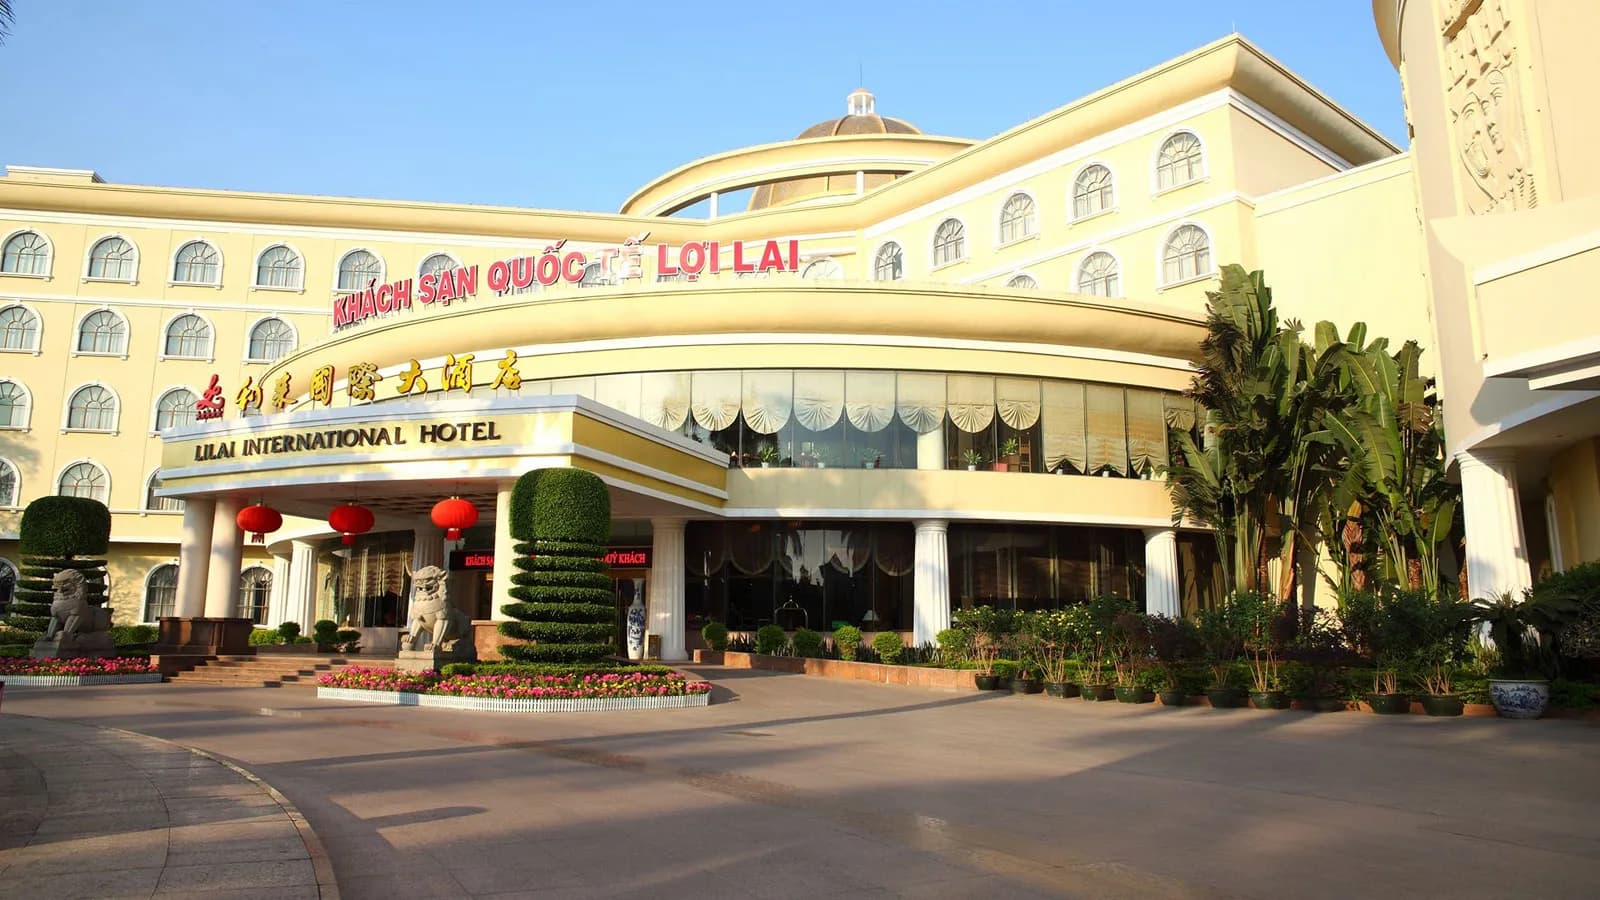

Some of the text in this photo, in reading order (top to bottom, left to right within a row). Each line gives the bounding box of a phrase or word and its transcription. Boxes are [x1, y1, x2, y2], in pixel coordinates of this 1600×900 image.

[333, 278, 412, 328] KHÁCH
[418, 265, 478, 305] SẠN
[487, 239, 587, 294] QUỐC
[657, 240, 721, 282] LỢI
[732, 239, 799, 273] LAI
[194, 421, 501, 462] LILAI INTERNATIONAL HOTEL
[618, 551, 646, 564] KHÁCH
